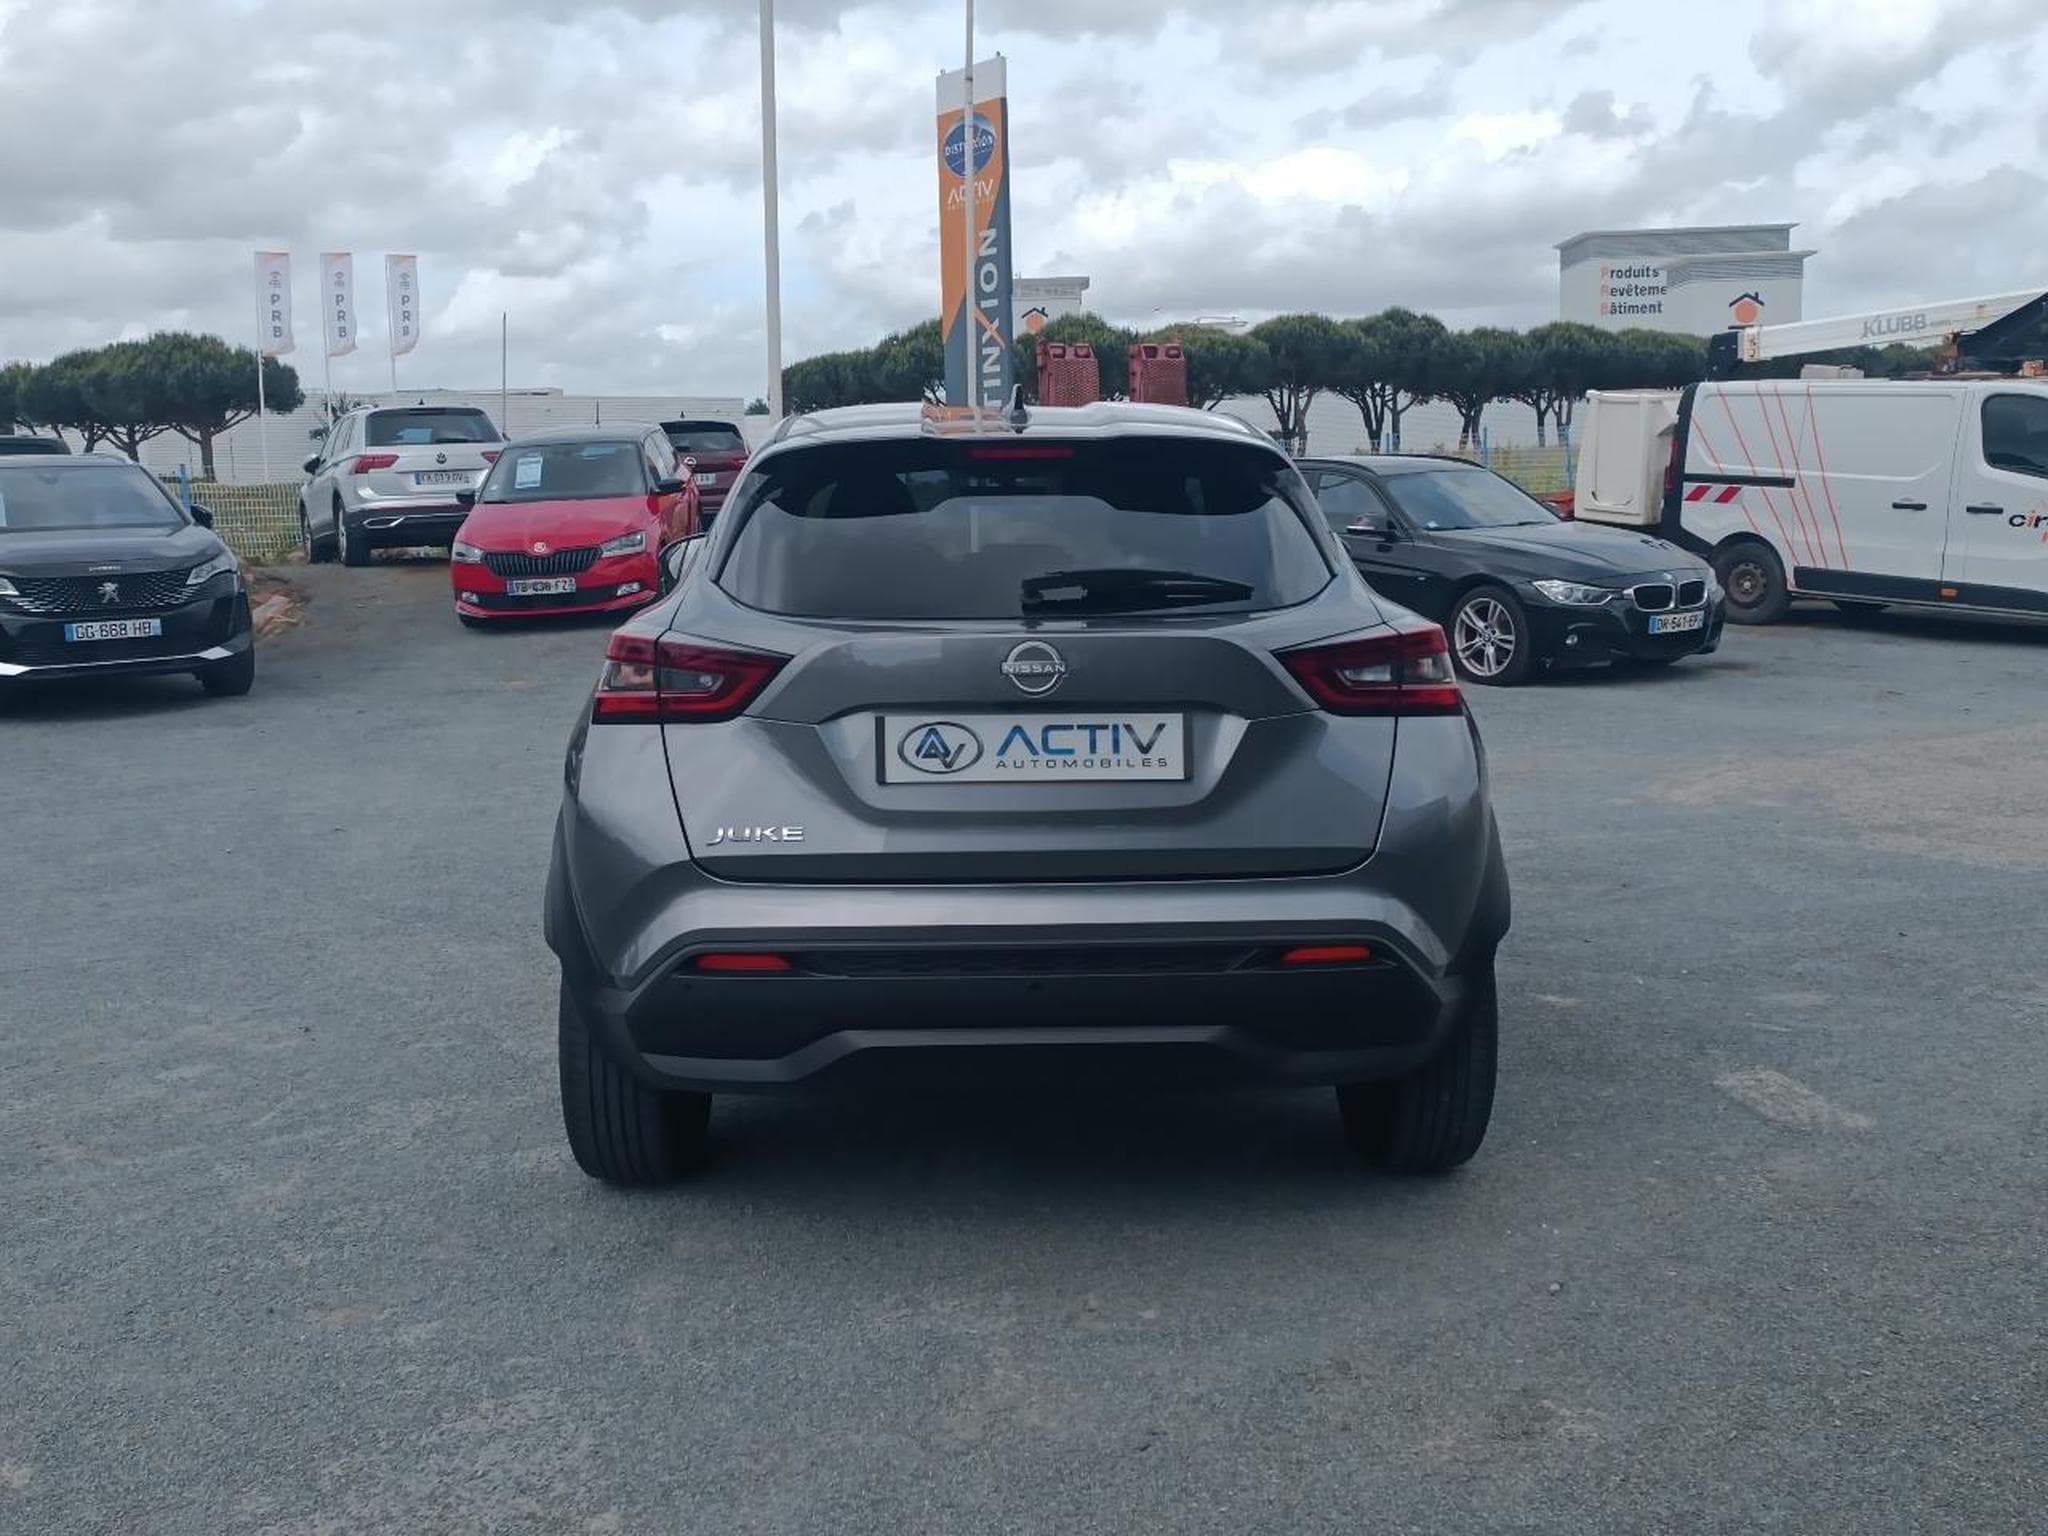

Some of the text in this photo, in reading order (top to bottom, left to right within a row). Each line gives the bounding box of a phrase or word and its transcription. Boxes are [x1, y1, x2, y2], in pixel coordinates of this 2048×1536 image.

[1601, 265, 1660, 279] Produits
[270, 293, 282, 338] PRB
[335, 293, 347, 338] PRB
[401, 294, 411, 337] PRB
[1601, 302, 1663, 315] Bâtiment
[1861, 314, 1926, 338] KLUBB
[1002, 661, 1065, 673] NISSAN
[996, 723, 1166, 756] ACTIV
[996, 757, 1168, 768] AUTOMOBILES
[706, 826, 804, 846] JUKE
